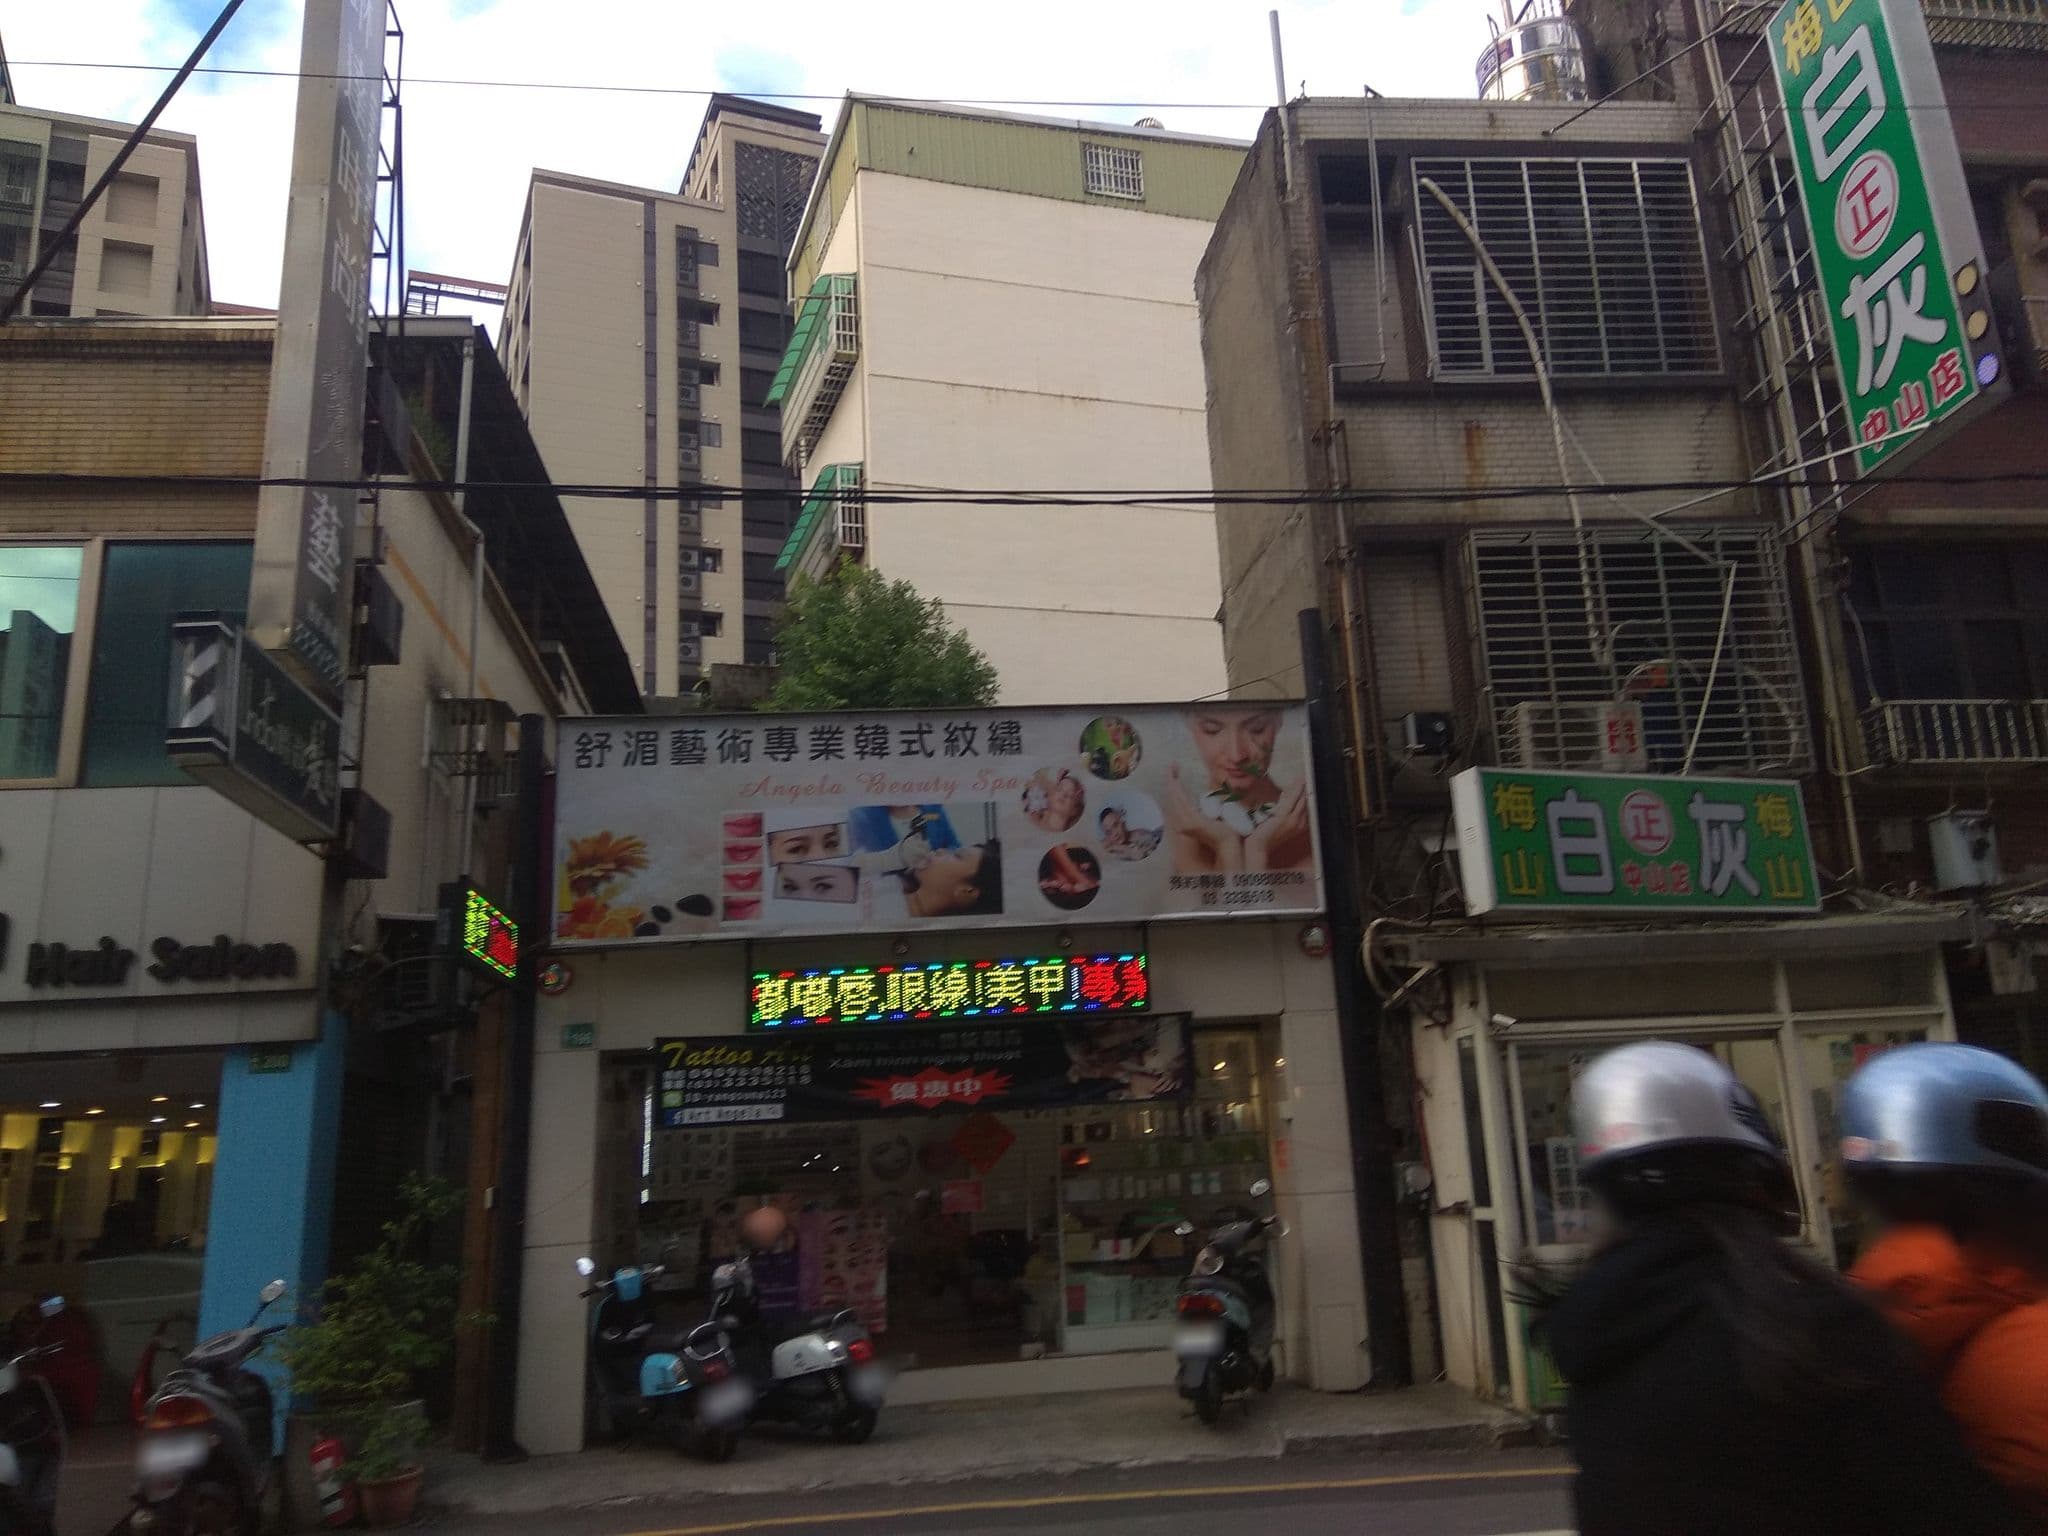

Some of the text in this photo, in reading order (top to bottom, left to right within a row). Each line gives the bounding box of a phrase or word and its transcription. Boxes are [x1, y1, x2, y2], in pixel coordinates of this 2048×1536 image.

[1860, 347, 1966, 452] 中山店
[574, 720, 1024, 769] 舒湄藝術專業韓式紋繡
[738, 769, 1017, 802] Angela Beauty Spa
[1494, 782, 1545, 896] 梅山
[1756, 792, 1804, 898] 梅山
[662, 1041, 752, 1068] Tattoo
